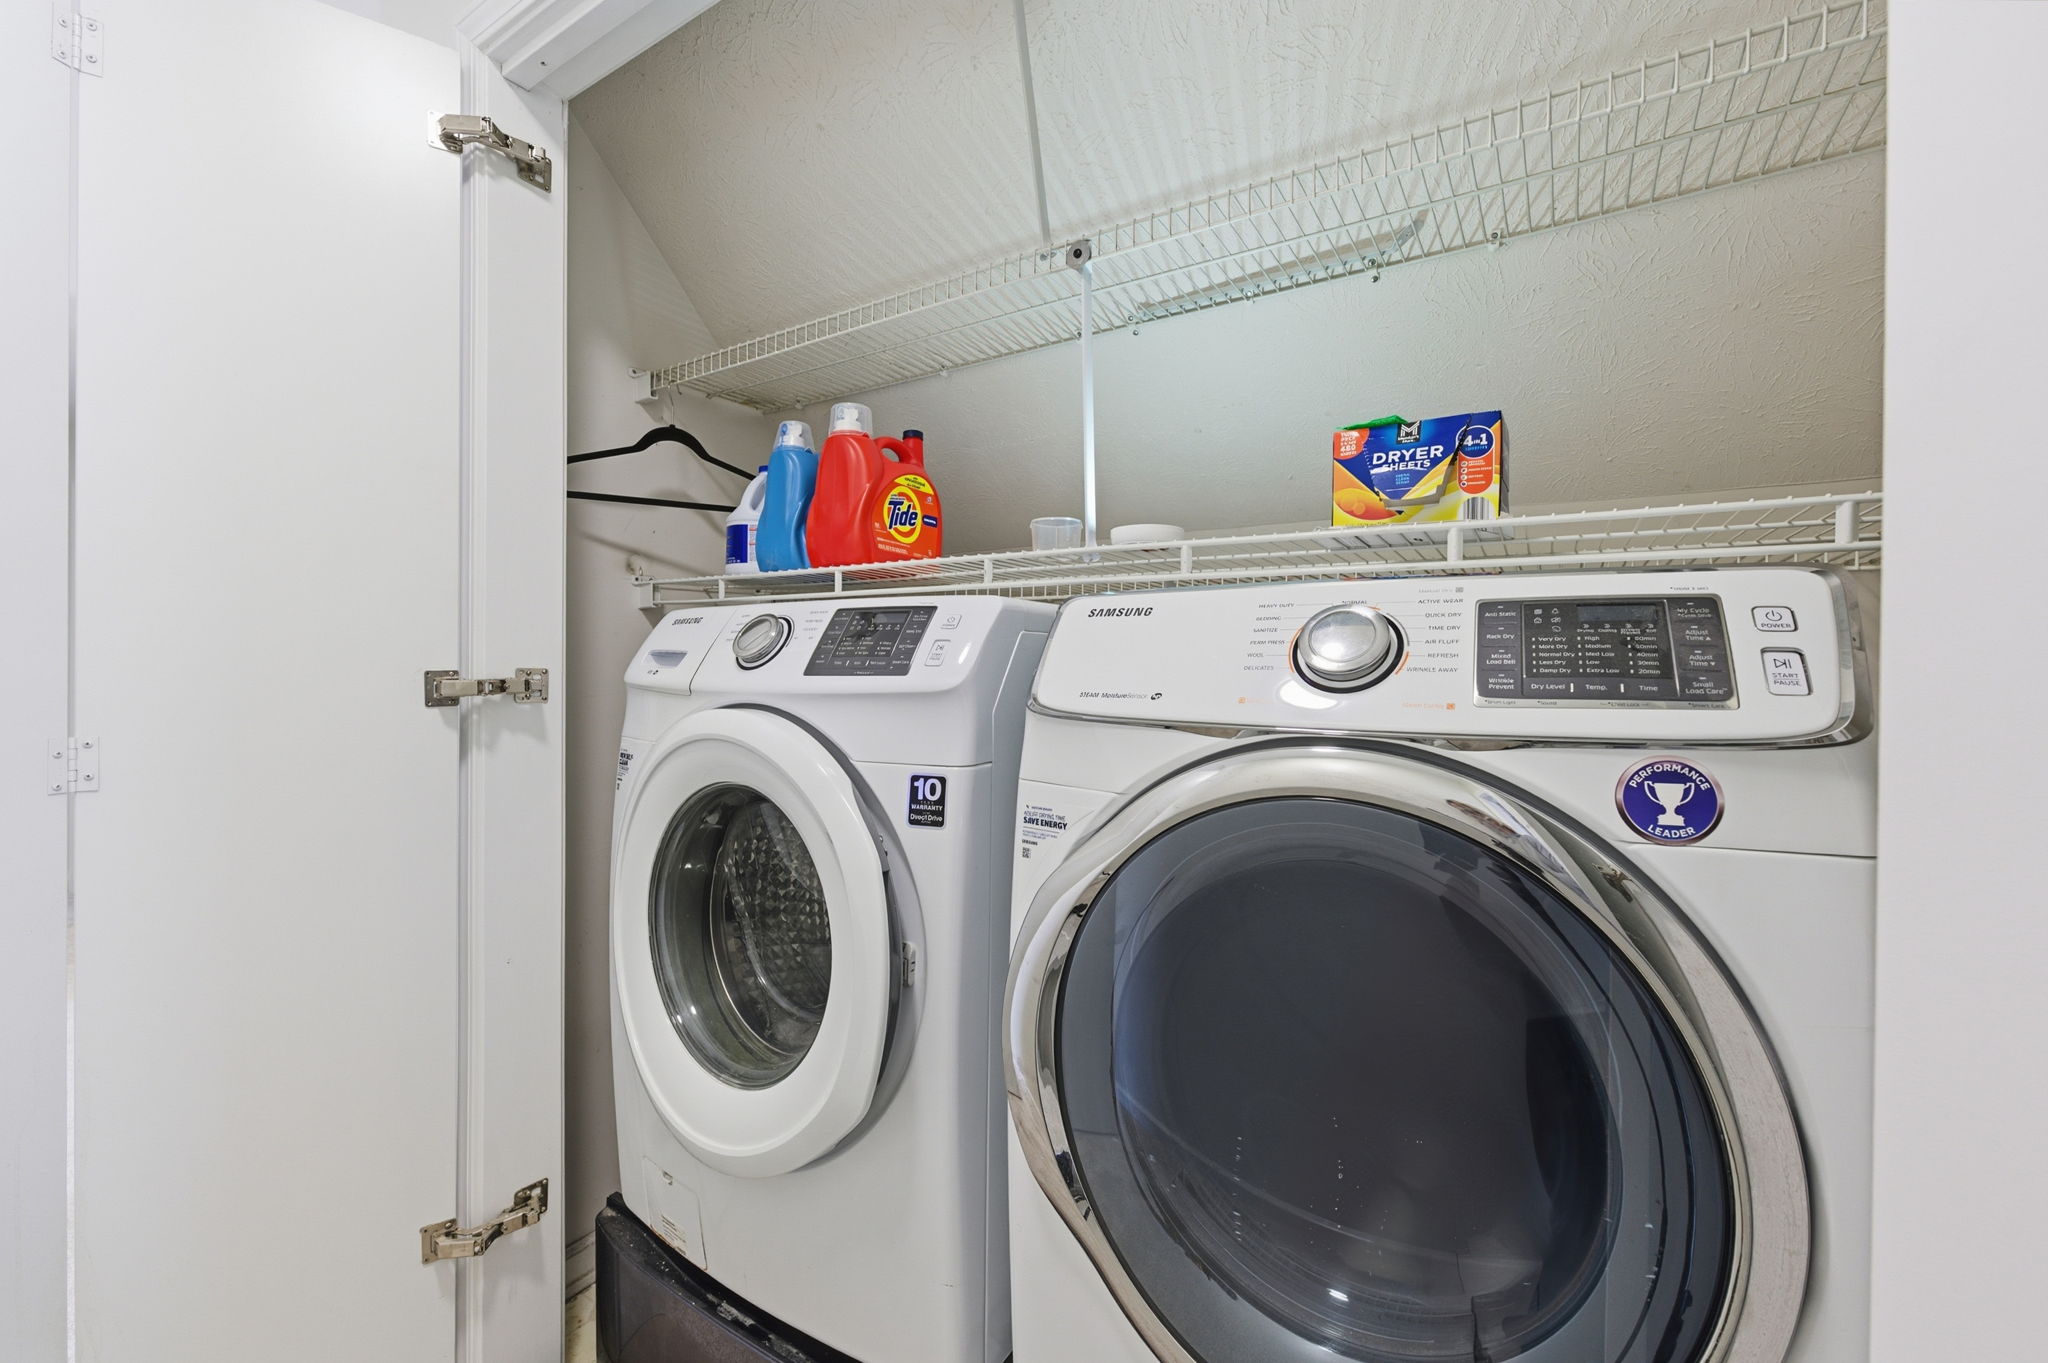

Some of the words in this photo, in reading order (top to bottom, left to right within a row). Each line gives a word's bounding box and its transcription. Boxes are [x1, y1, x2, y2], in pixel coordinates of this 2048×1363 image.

[1372, 444, 1444, 465] DRYER
[1382, 459, 1431, 471] SHEETS
[888, 500, 919, 530] Tide
[1088, 607, 1153, 618] SAMSUNG
[671, 617, 704, 626] SAMSUNG
[1629, 763, 1711, 791] PERFORMANCE
[914, 777, 942, 801] 10
[1023, 816, 1040, 826] SAVE
[1040, 819, 1068, 830] ENERGY
[1648, 824, 1696, 838] LEADER
